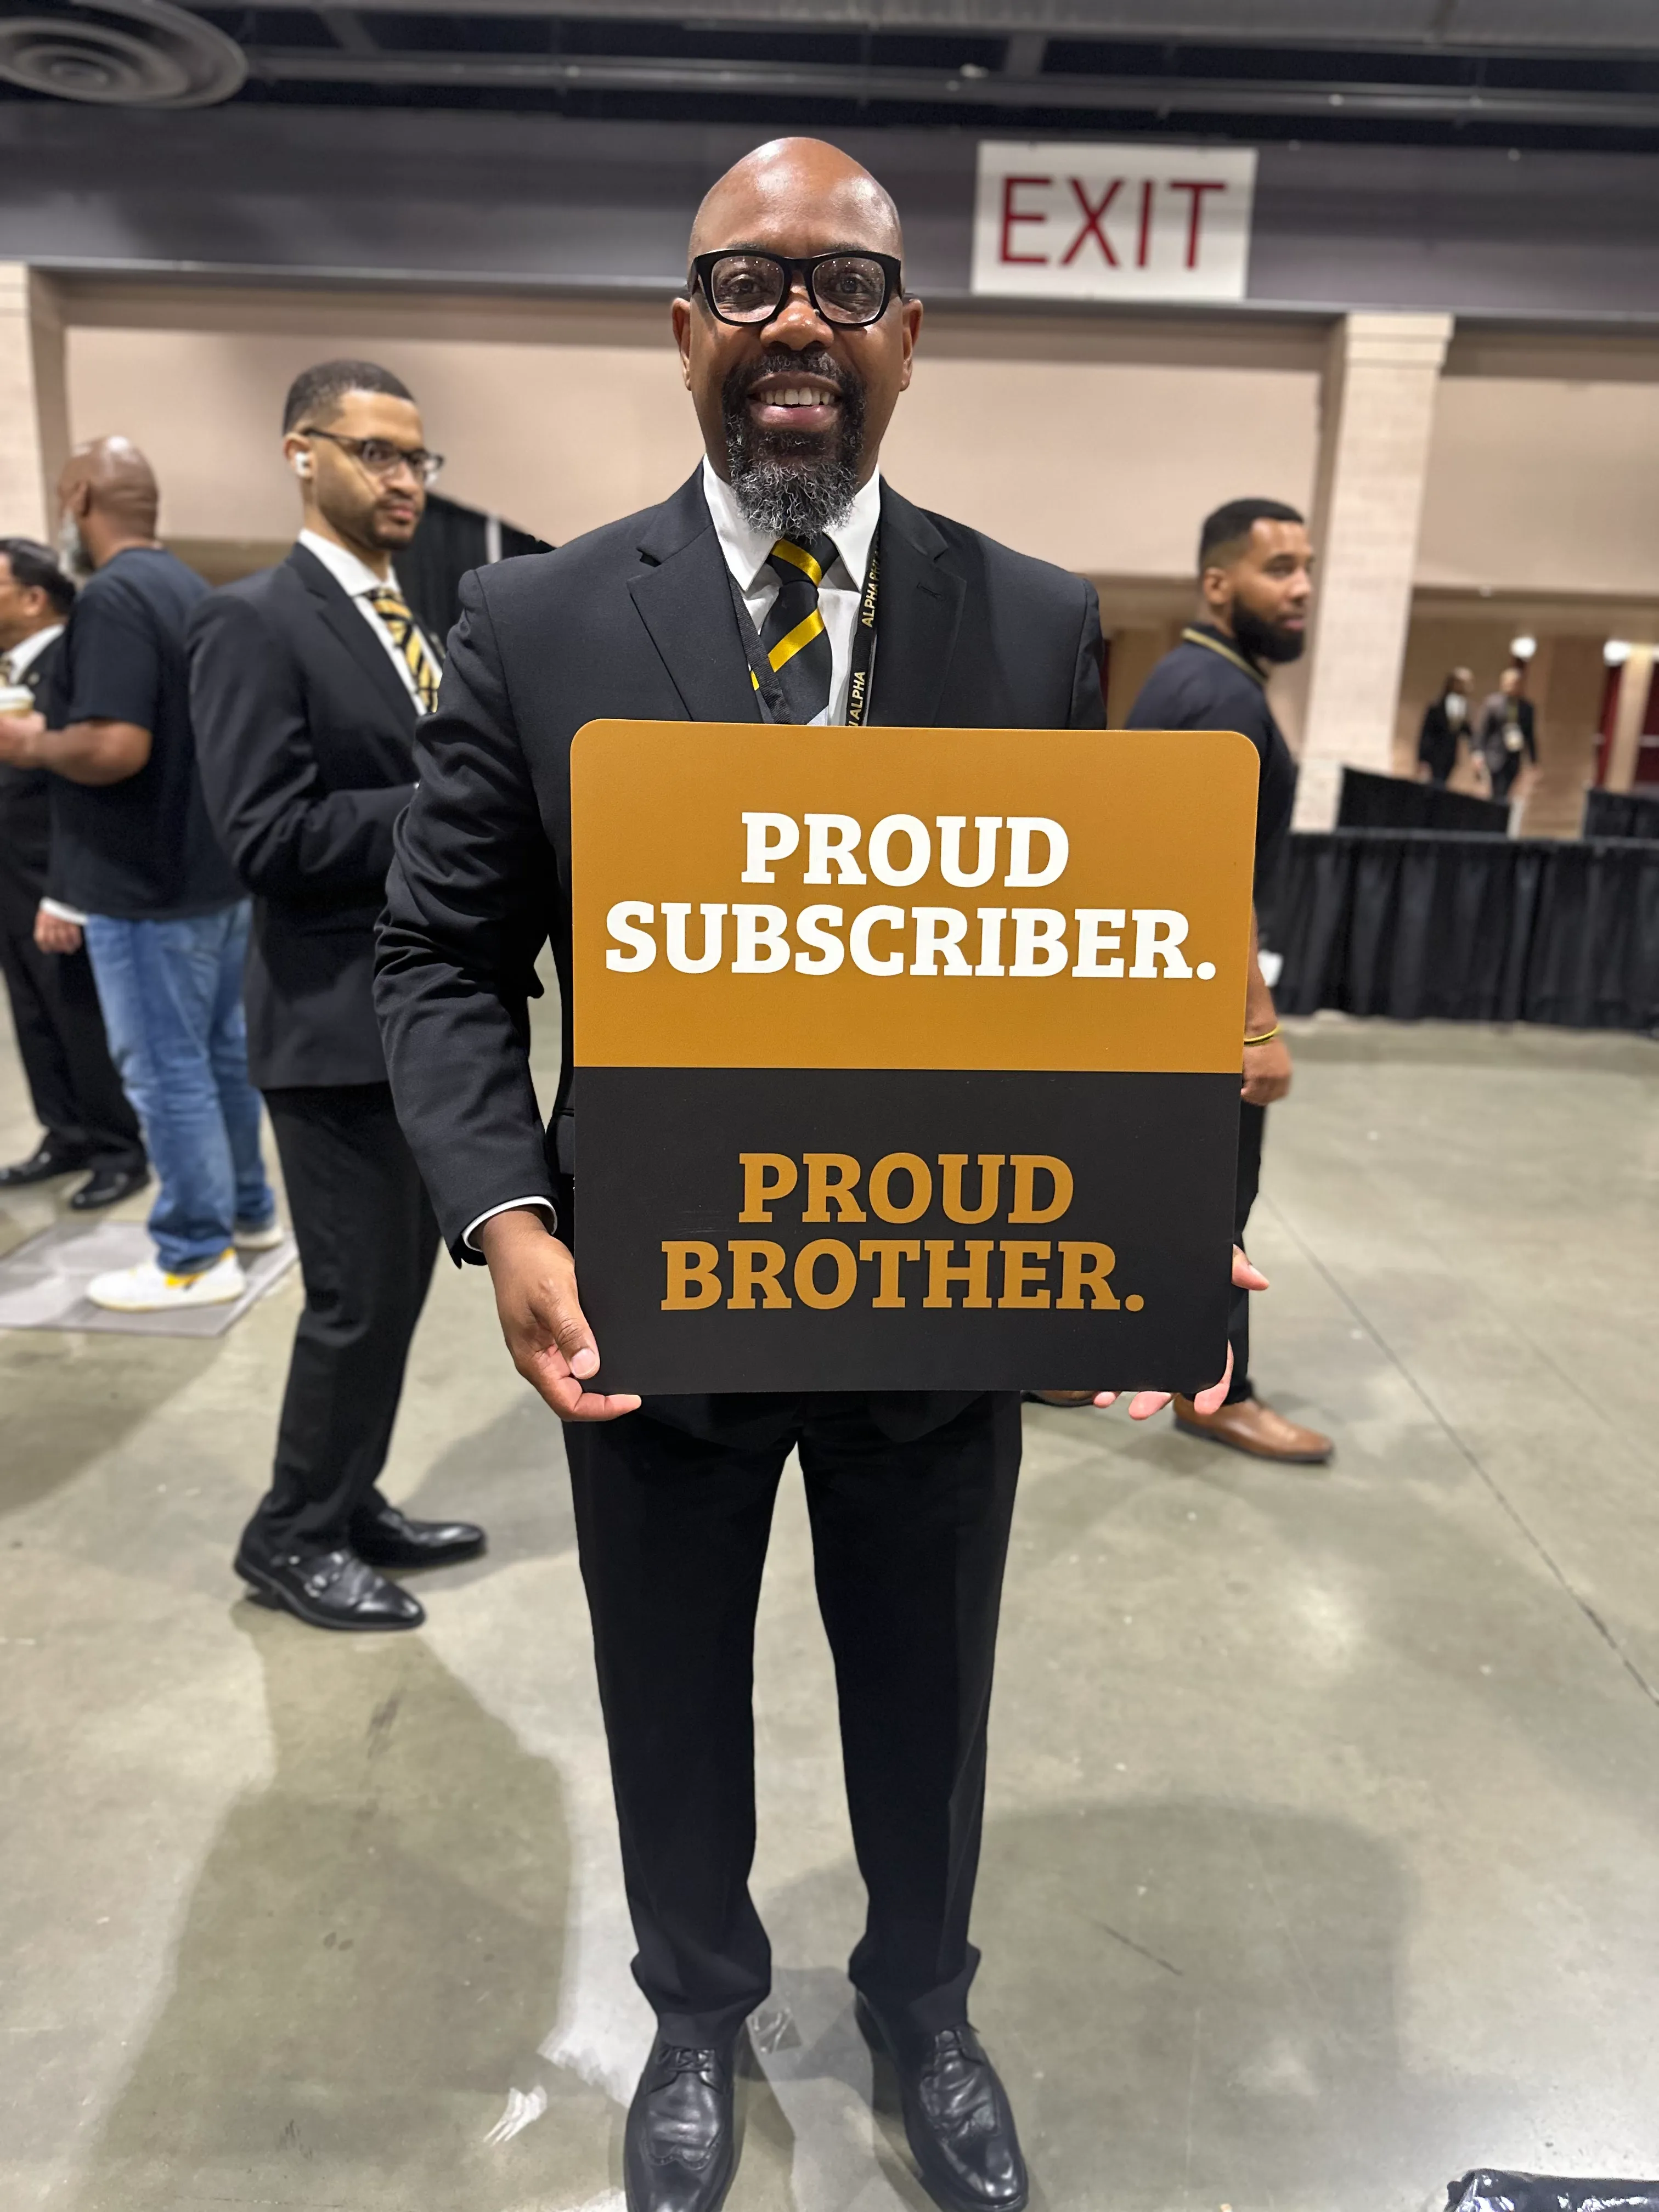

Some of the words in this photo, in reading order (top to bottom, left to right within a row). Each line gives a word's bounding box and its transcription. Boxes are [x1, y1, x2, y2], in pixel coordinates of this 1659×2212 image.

[998, 174, 1227, 269] EXIT
[861, 582, 878, 628] ALPHA
[850, 672, 866, 720] ALPHA
[741, 811, 1069, 888] PROUD
[605, 900, 1216, 980] SUBSCRIBER.
[738, 1152, 1074, 1224] PROUD
[661, 1238, 1144, 1312] BROTHER.
